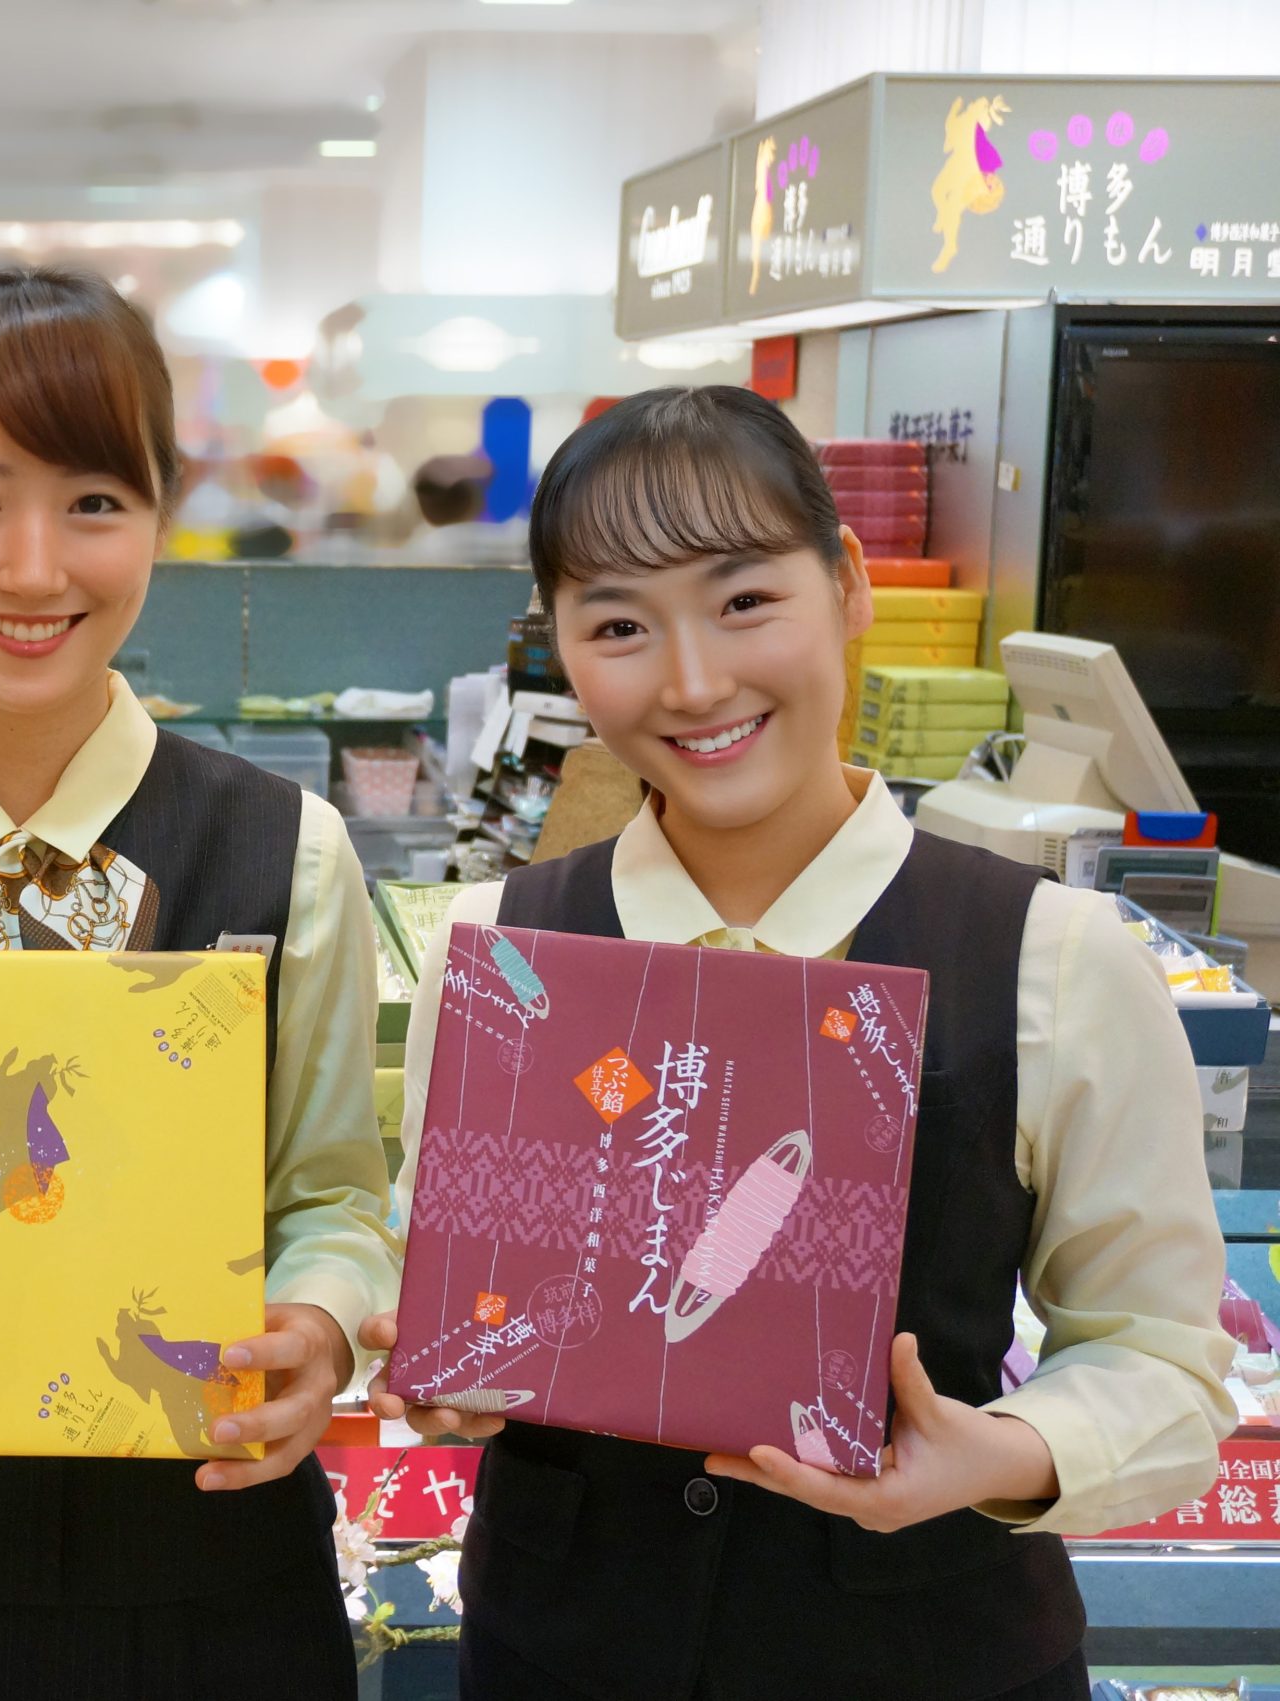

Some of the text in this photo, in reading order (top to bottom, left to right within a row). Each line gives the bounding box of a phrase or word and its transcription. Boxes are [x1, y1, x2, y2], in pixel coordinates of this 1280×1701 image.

[1057, 160, 1133, 216] 博多
[1010, 215, 1172, 266] 通りもん
[444, 957, 535, 1029] 多じまん
[590, 1065, 605, 1104] 仕立て
[723, 1060, 735, 1095] HAKATA
[719, 1096, 731, 1122] SEIYO
[714, 1124, 728, 1165] WAGASHI
[628, 1040, 710, 1315] 博多じまん
[582, 1132, 613, 1298] 博多西洋和菓子
